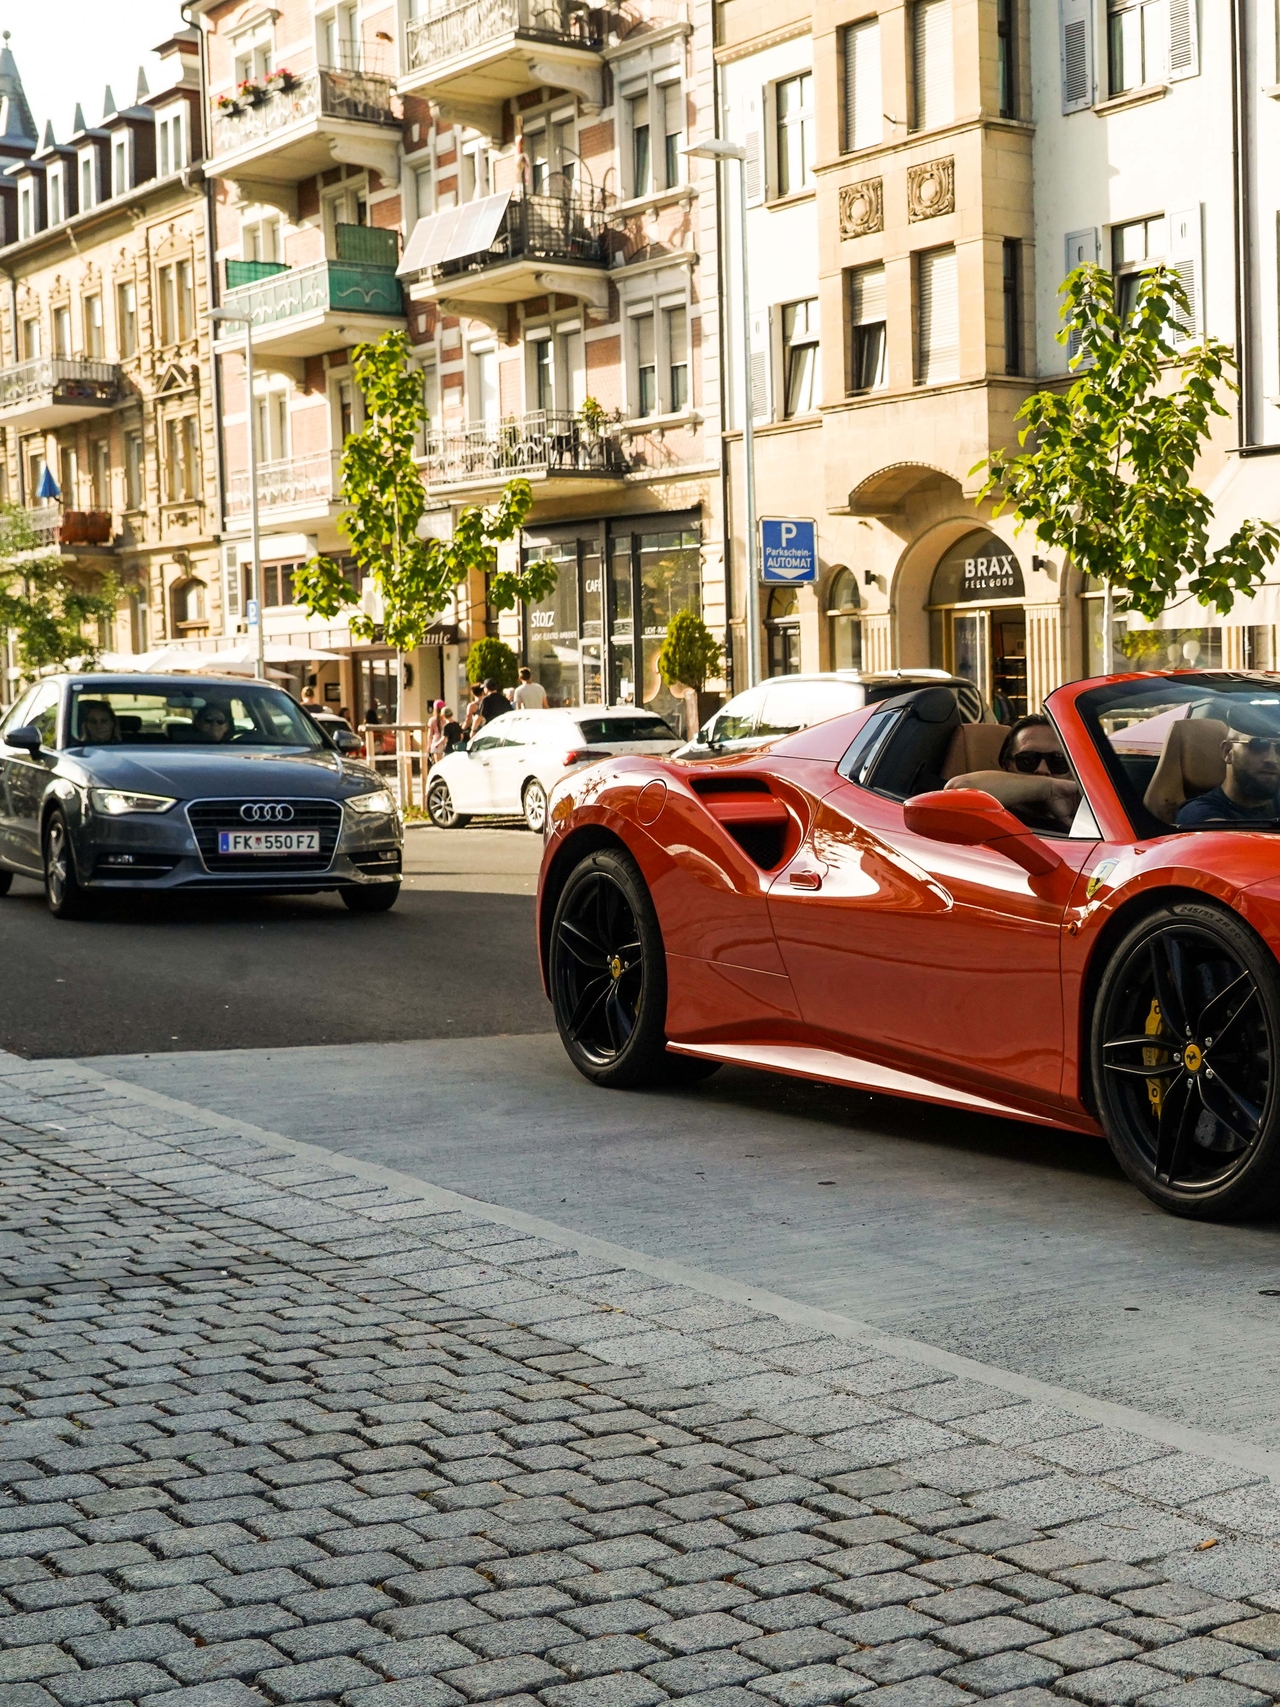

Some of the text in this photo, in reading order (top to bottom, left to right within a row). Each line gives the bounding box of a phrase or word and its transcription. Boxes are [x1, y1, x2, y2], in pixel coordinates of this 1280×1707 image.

[781, 522, 797, 548] P
[765, 547, 812, 557] Parkschein-
[767, 557, 812, 568] AUTOMAT
[965, 554, 1014, 578] BRAX
[965, 577, 1014, 589] FEEL GOOD
[531, 609, 555, 628] storz
[233, 835, 253, 850] FK
[264, 835, 293, 849] 550
[296, 835, 315, 849] FZ
[1179, 906, 1214, 919] 245/35
